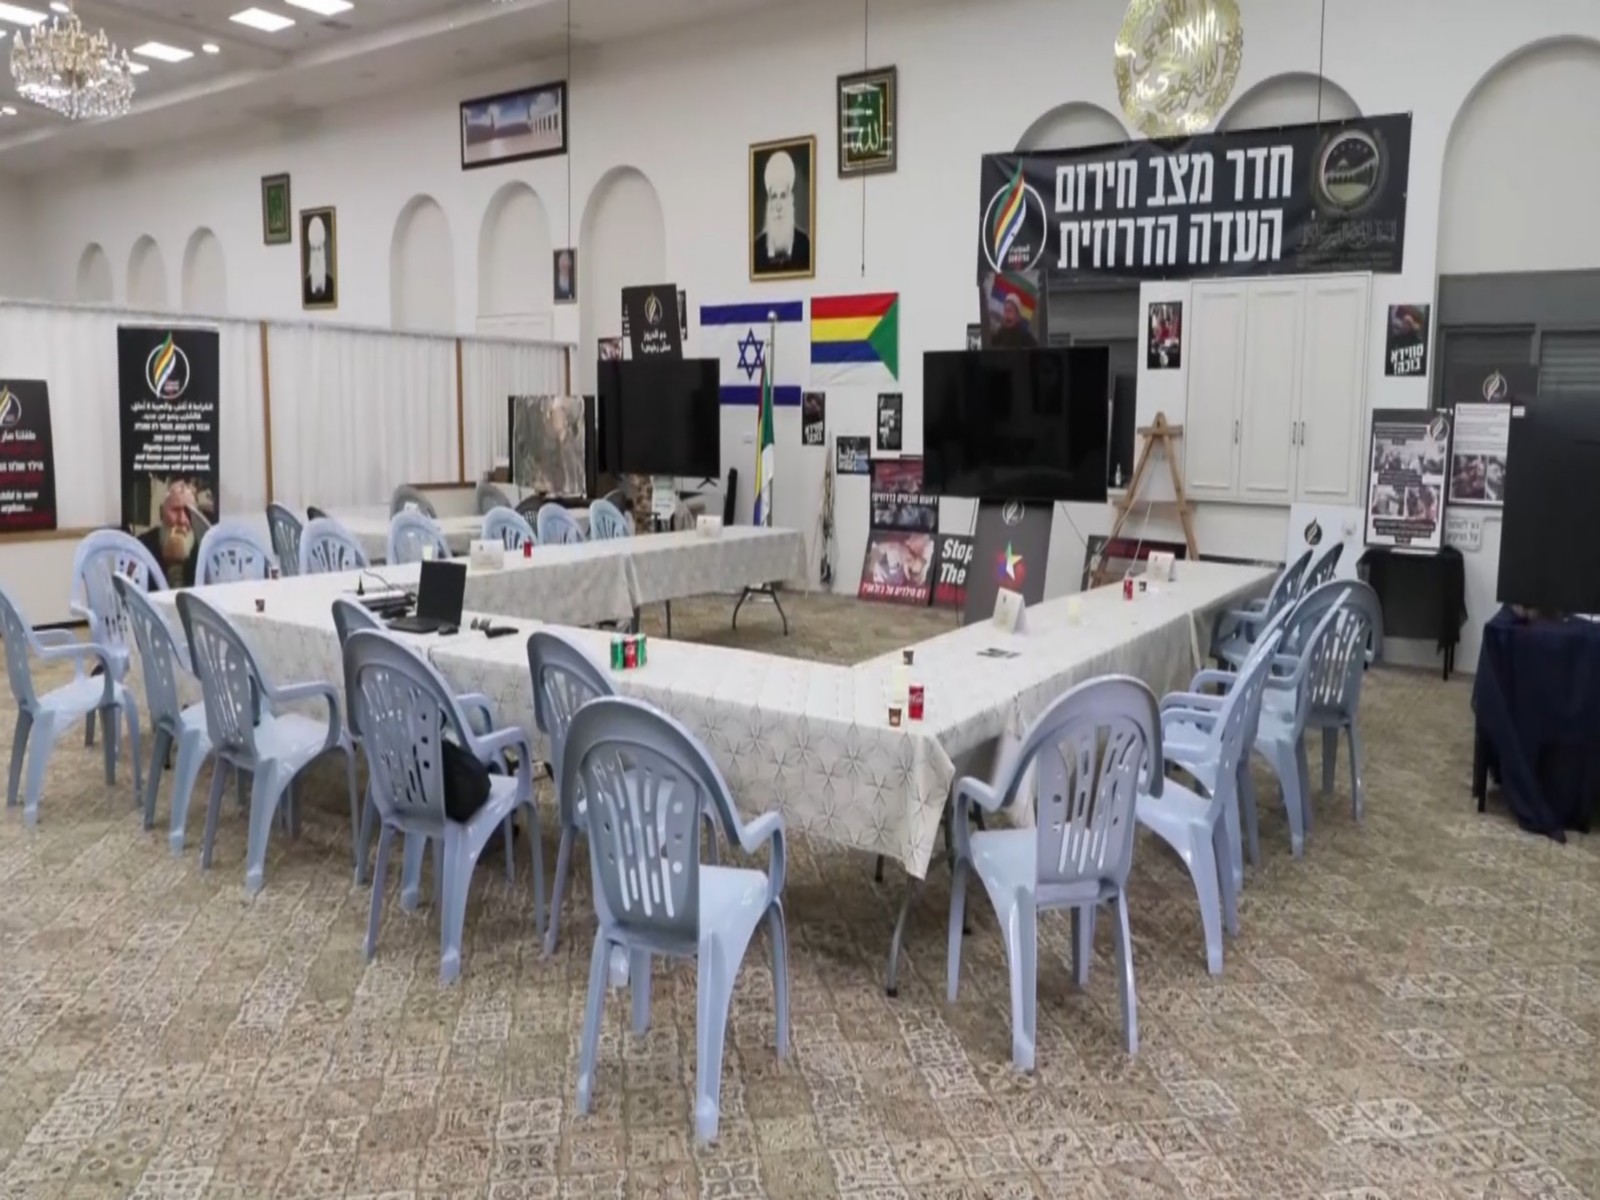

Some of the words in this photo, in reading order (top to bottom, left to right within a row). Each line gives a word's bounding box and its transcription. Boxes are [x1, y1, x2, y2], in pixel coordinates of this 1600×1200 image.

[1054, 159, 1138, 213] חירום
[1146, 152, 1214, 206] מצב
[1226, 145, 1294, 200] חדר
[1057, 215, 1179, 269] הדרוזית
[1189, 209, 1283, 265] העדה
[940, 562, 966, 585] The
[942, 538, 974, 565] Stop
